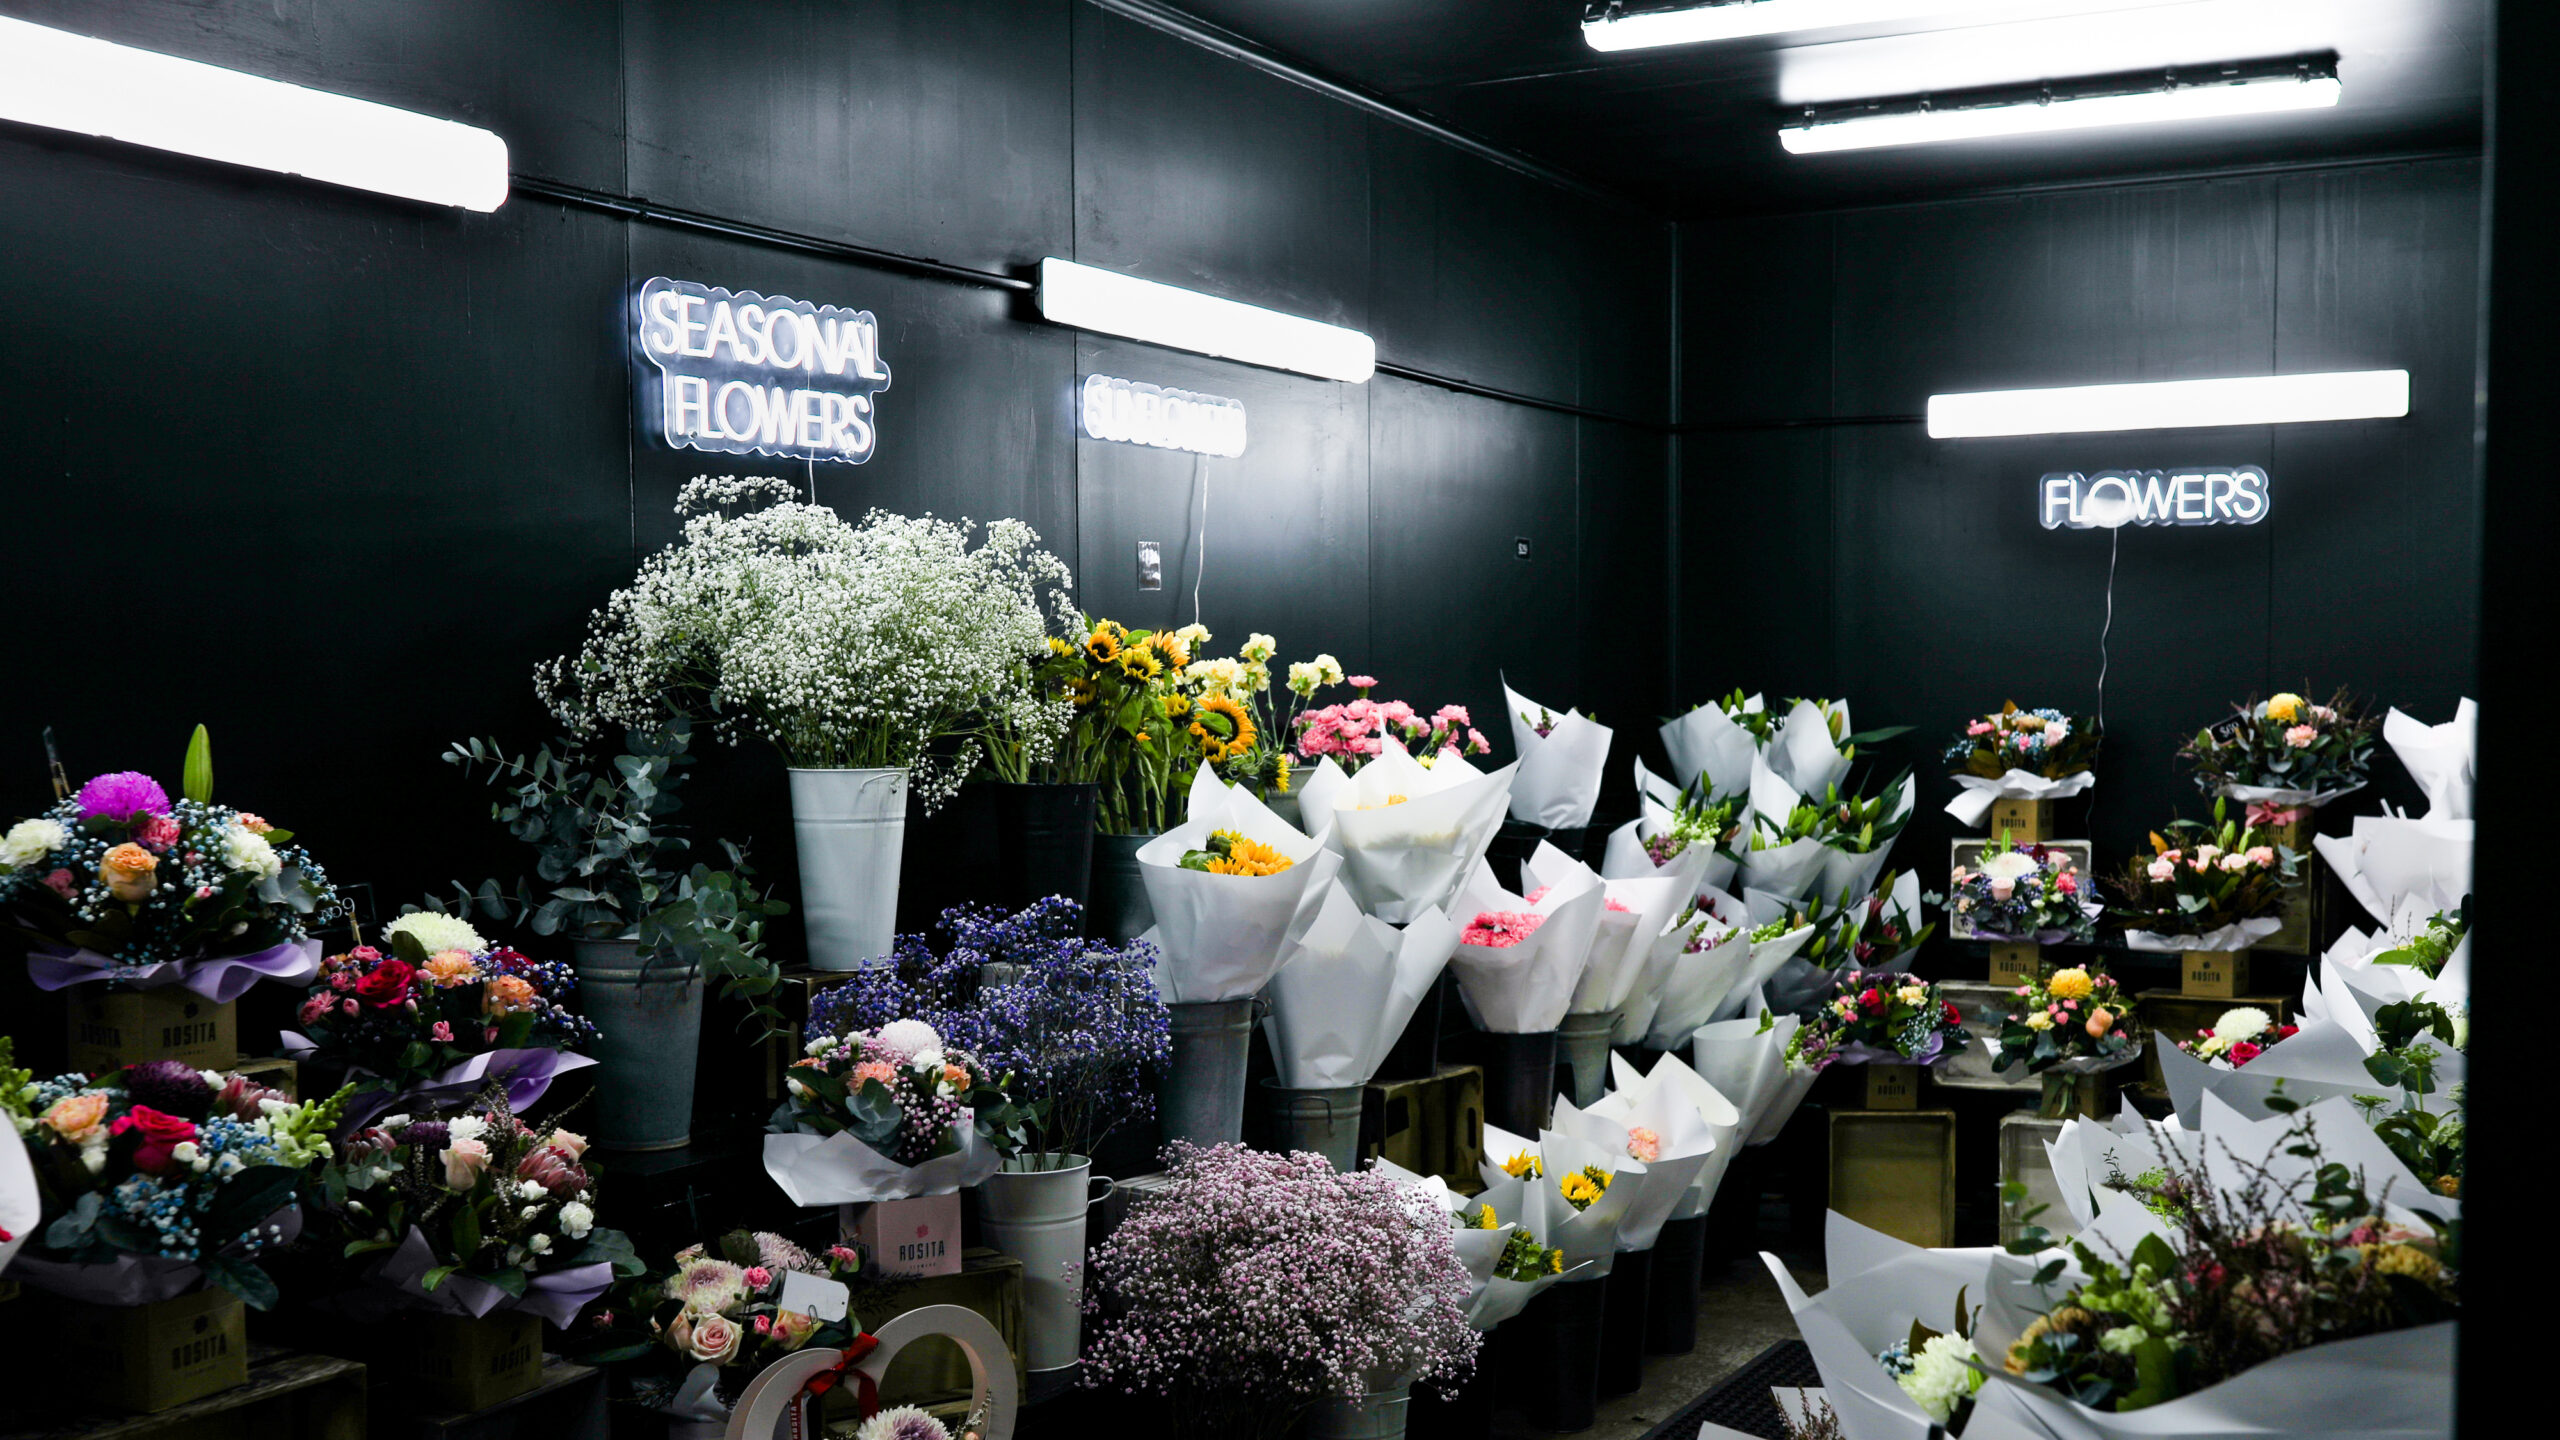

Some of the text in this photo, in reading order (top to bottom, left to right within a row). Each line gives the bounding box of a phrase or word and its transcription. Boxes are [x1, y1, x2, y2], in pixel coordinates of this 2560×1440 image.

[650, 289, 887, 381] SEASONAL
[673, 374, 873, 453] FLOWERS
[2045, 471, 2263, 524] FLOWERS
[162, 1021, 216, 1048] ROSITA
[899, 1239, 945, 1262] ROSITA
[172, 1333, 226, 1370] ROSITA
[491, 1343, 530, 1375] ROSITA
